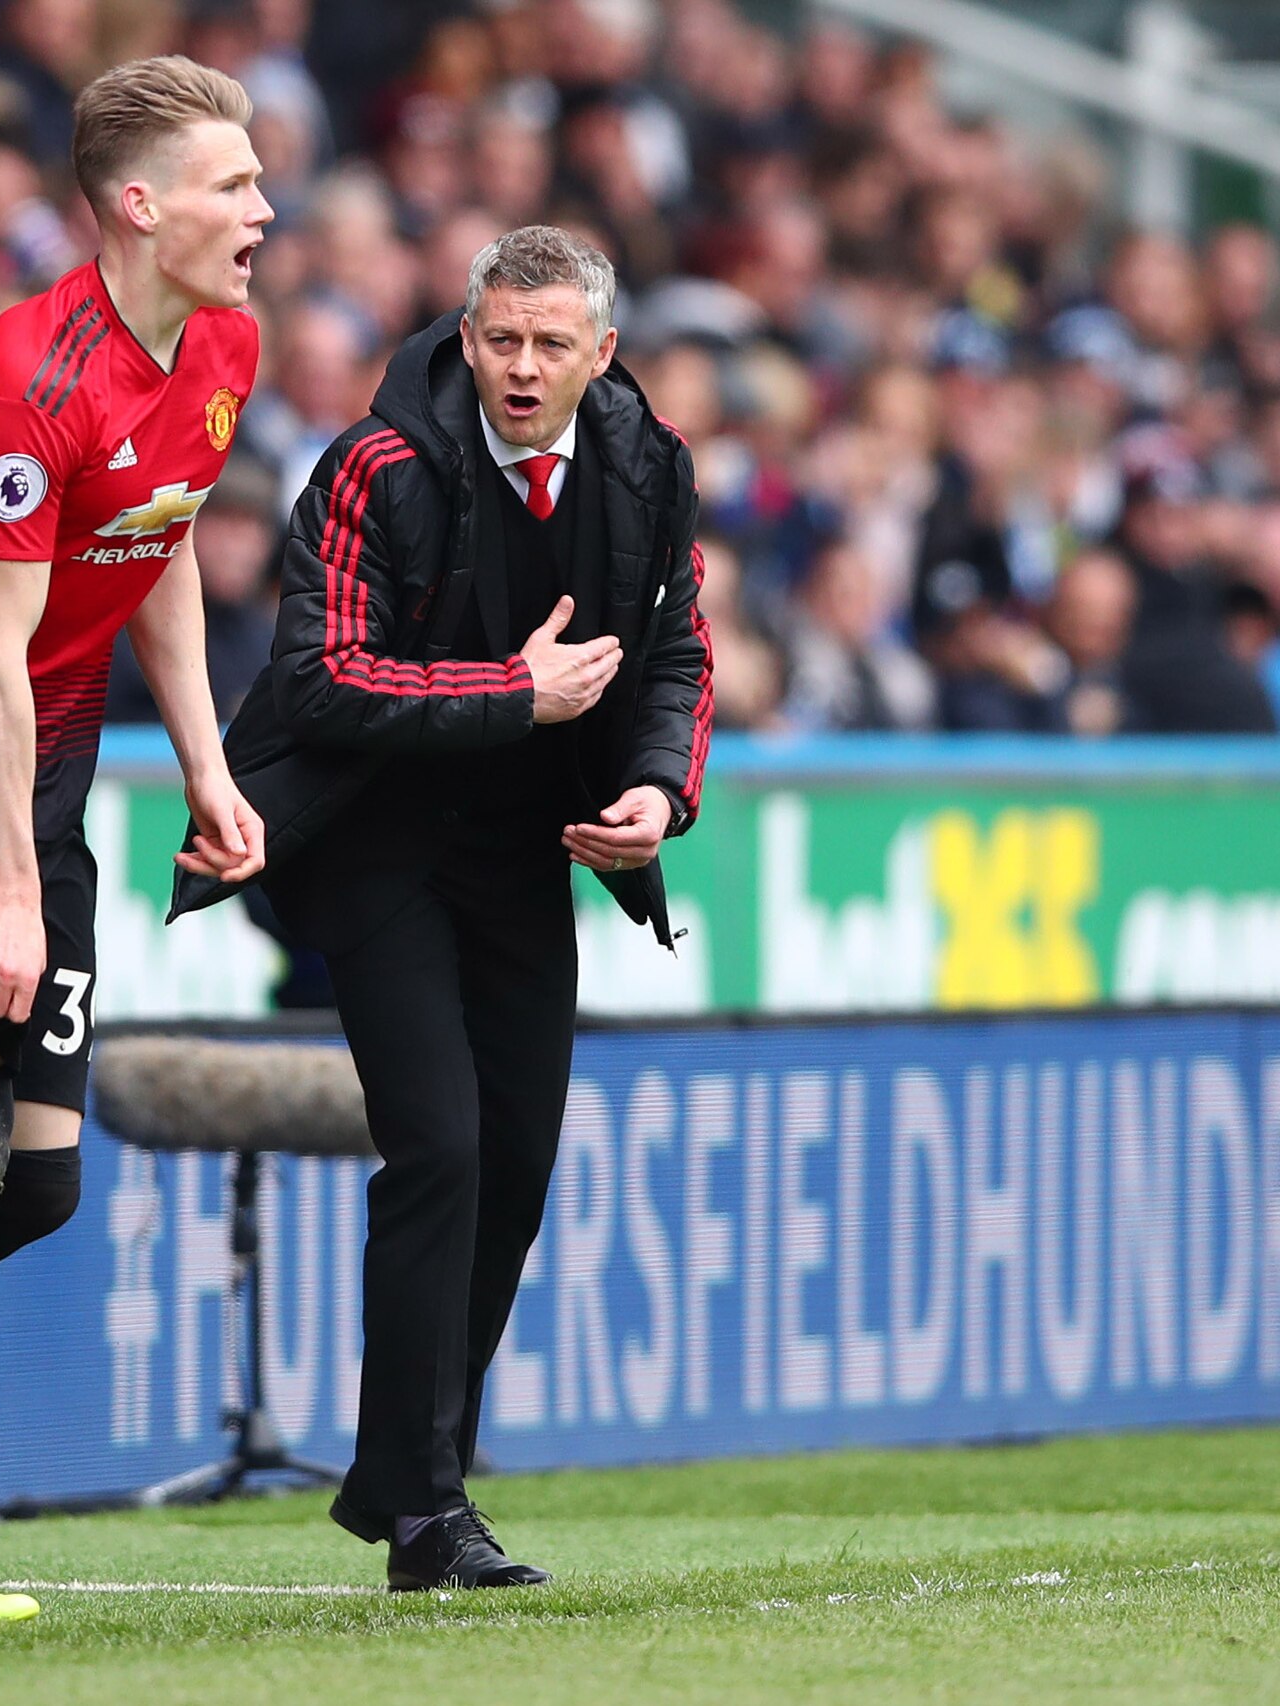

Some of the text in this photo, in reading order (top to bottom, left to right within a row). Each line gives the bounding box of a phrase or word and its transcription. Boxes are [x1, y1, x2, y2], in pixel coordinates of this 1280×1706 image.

[107, 454, 138, 471] adidas
[71, 541, 184, 565] HEVROLE
[41, 966, 97, 1063] 3
